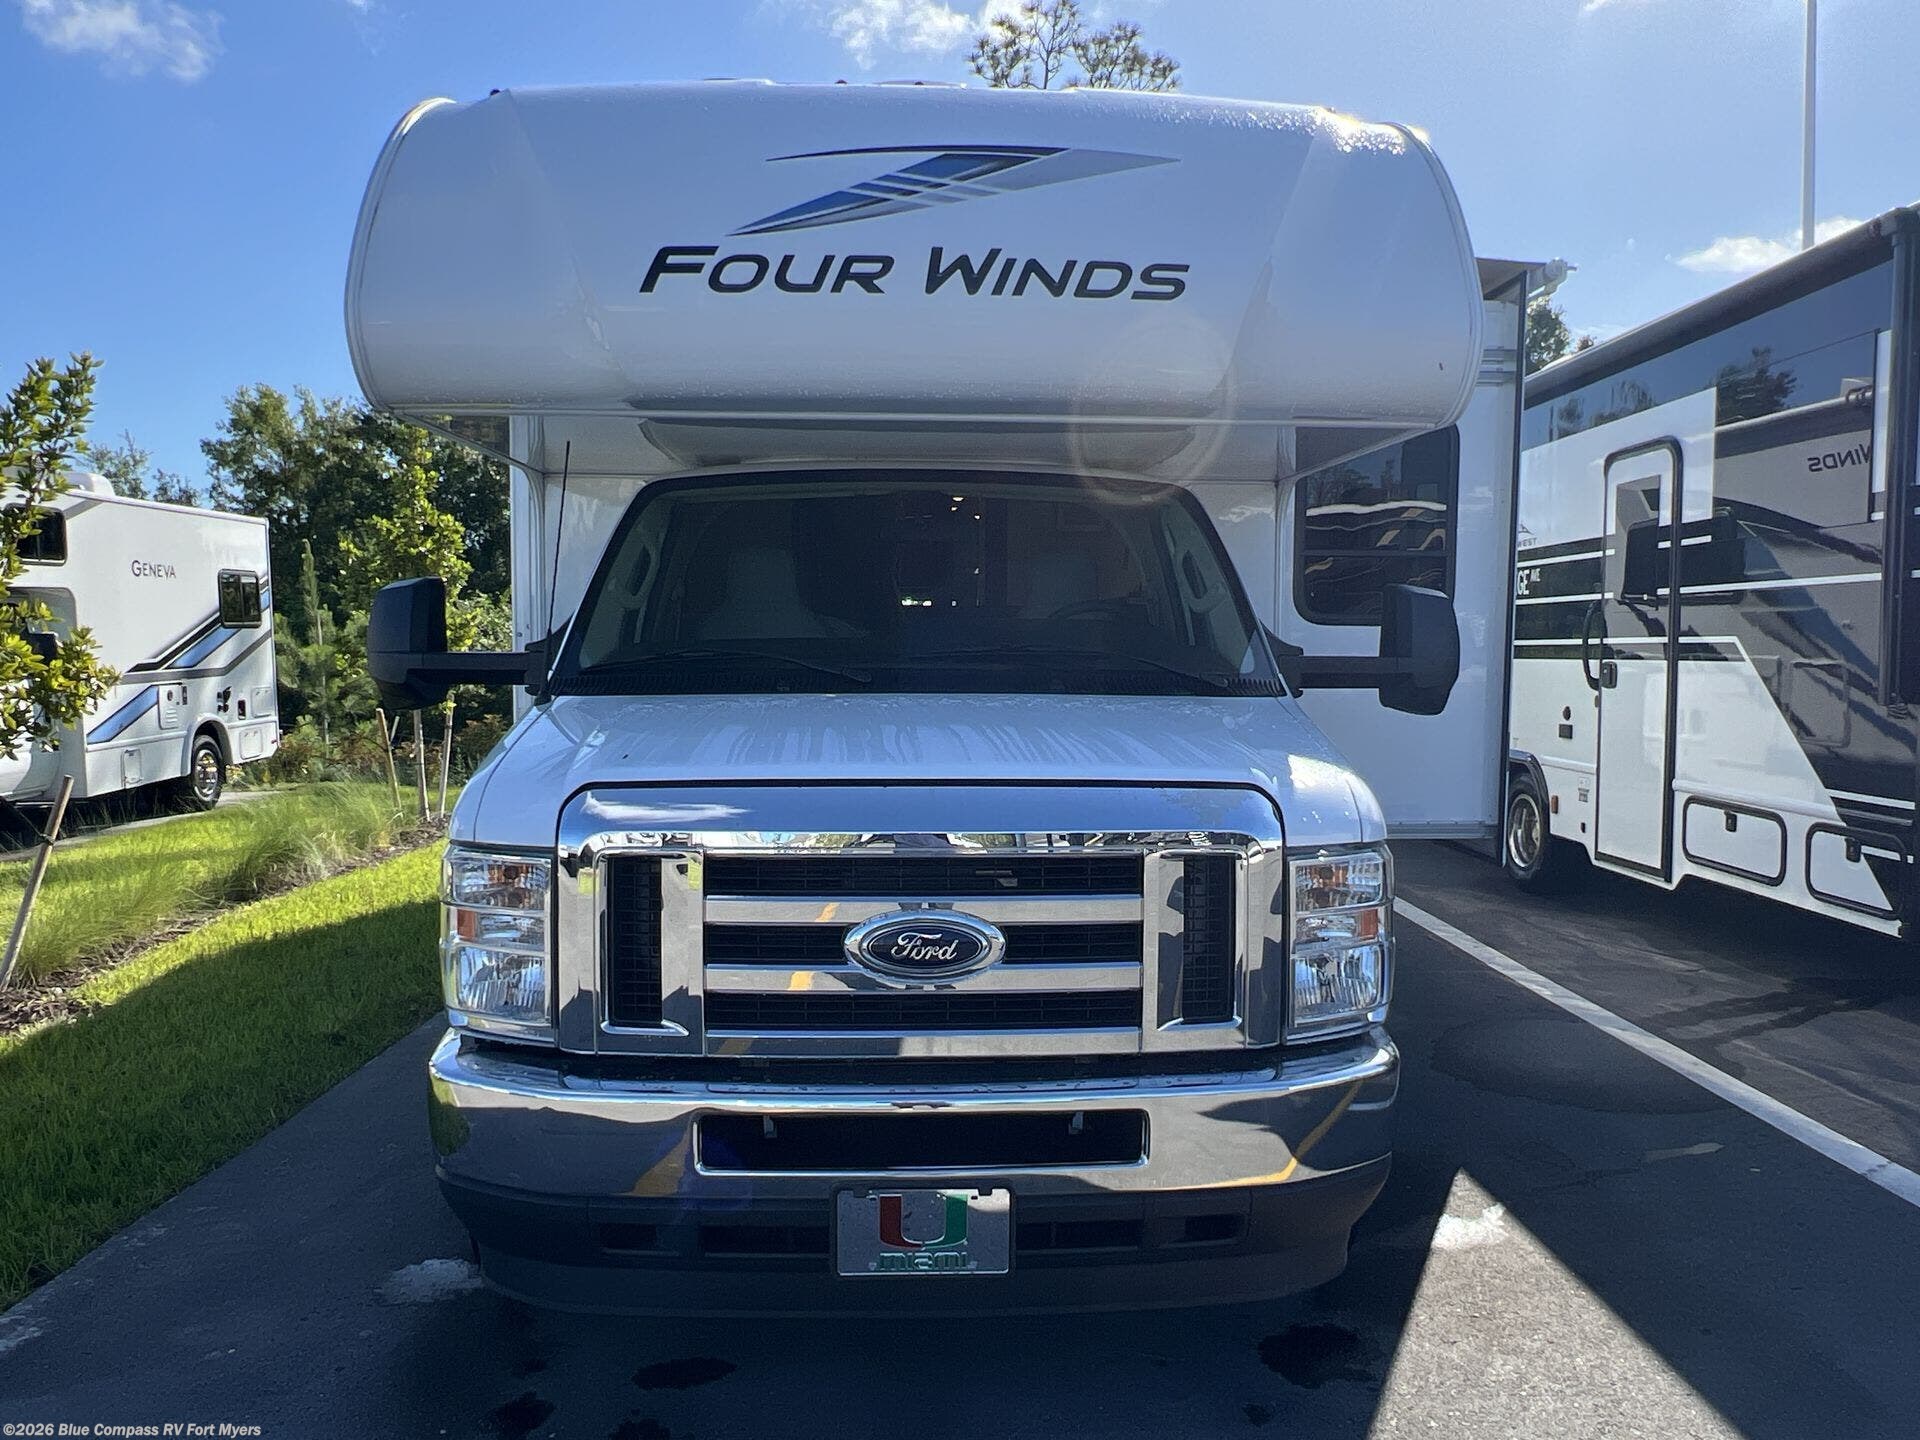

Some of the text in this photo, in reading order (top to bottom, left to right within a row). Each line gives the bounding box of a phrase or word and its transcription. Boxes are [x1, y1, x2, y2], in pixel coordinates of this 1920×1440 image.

[639, 245, 1190, 300] FOUR WINDS
[131, 559, 177, 579] GENEVA
[890, 932, 957, 960] Ford
[878, 1193, 968, 1250] U
